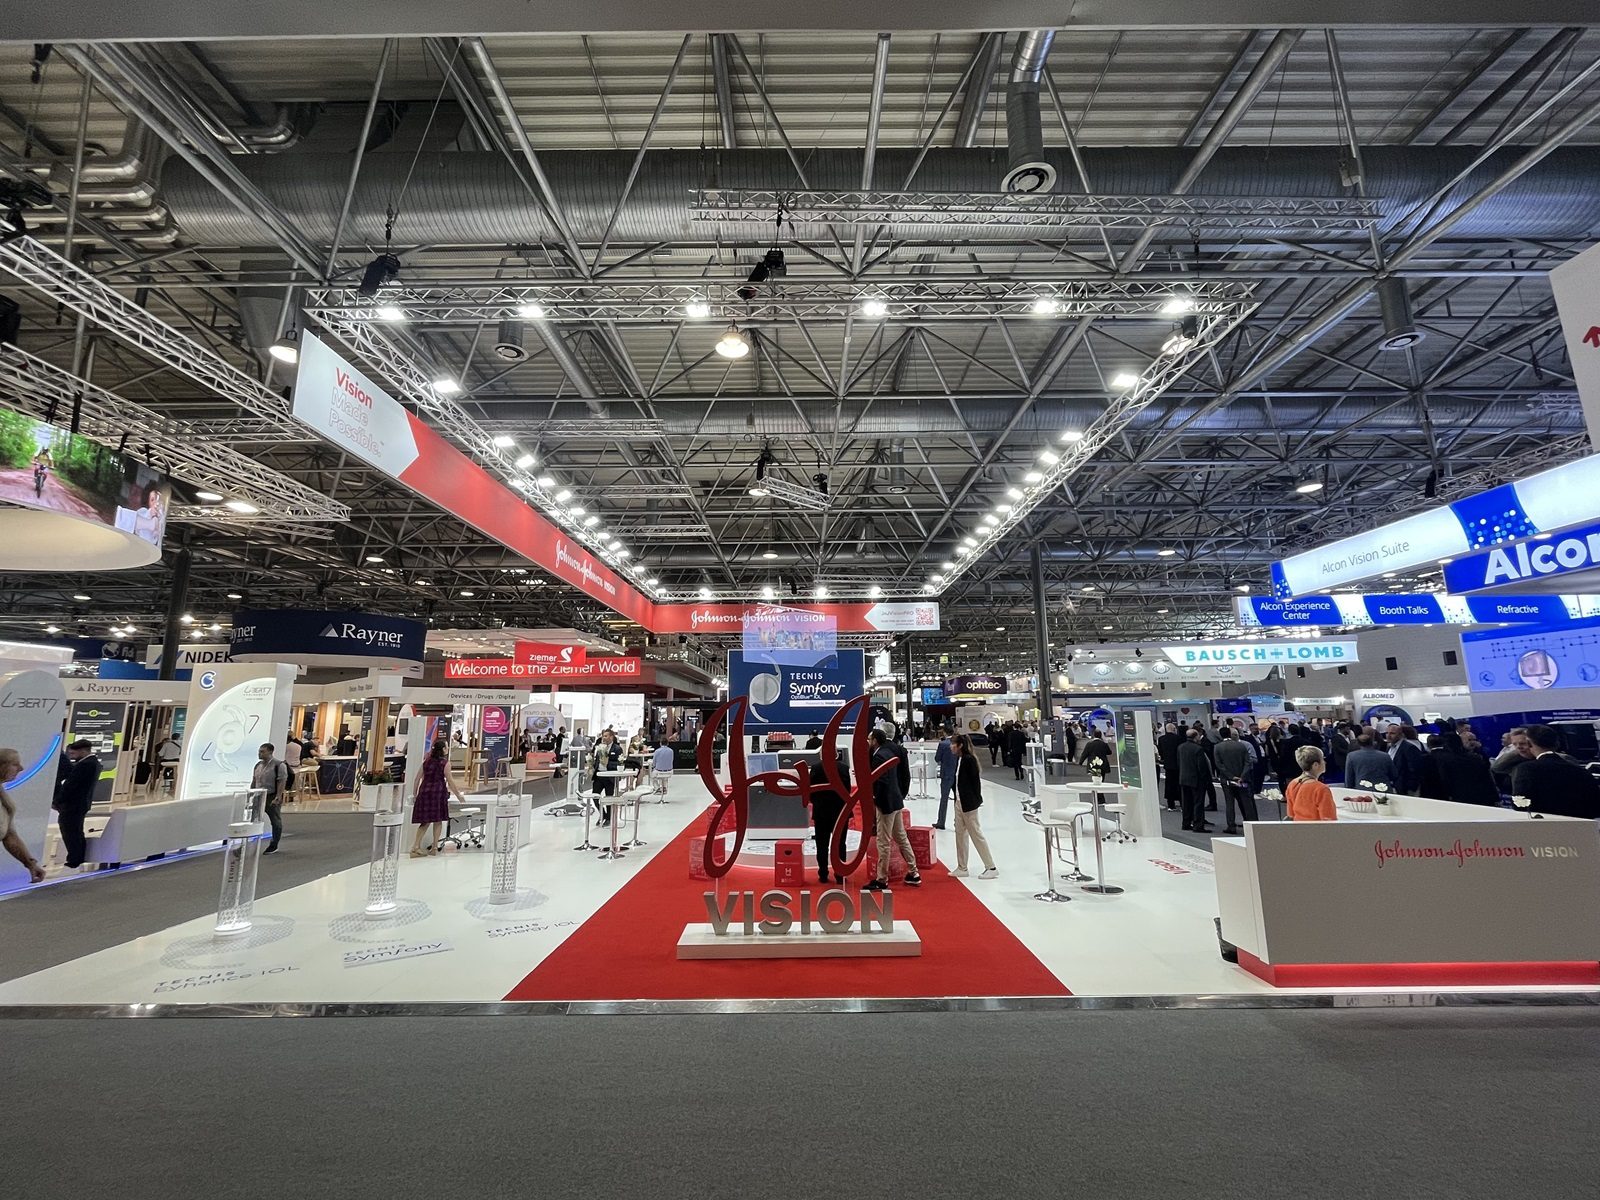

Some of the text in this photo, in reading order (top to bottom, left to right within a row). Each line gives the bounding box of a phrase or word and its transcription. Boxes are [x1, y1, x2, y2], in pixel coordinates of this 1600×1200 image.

[336, 366, 373, 409] Vision
[331, 387, 369, 426] Made
[1322, 541, 1410, 574] Alcon Vision Suite
[1260, 602, 1331, 611] Alcon Experience
[1379, 605, 1429, 615] Booth Talks
[1497, 605, 1539, 614] Refractive
[794, 614, 826, 623] VISION
[1282, 612, 1311, 620] Center
[341, 623, 403, 645] Rayner
[185, 651, 234, 663] NIDEK
[530, 653, 557, 663] ziemer
[450, 662, 508, 675] Welcome
[511, 663, 524, 674] to
[528, 663, 548, 674] the
[599, 660, 635, 674] World
[789, 672, 823, 680] TECNIS
[87, 683, 135, 696] Rayner
[966, 680, 1001, 691] ophtec
[1530, 846, 1579, 858] VISION
[704, 888, 895, 936] VISION
[485, 923, 539, 934] TECNIS
[488, 926, 549, 938] Synergy
[344, 944, 406, 956] TECNIS
[344, 942, 442, 962] Symfony
[153, 966, 300, 993] Eyhance IOL
[157, 970, 236, 986] TECNIS
